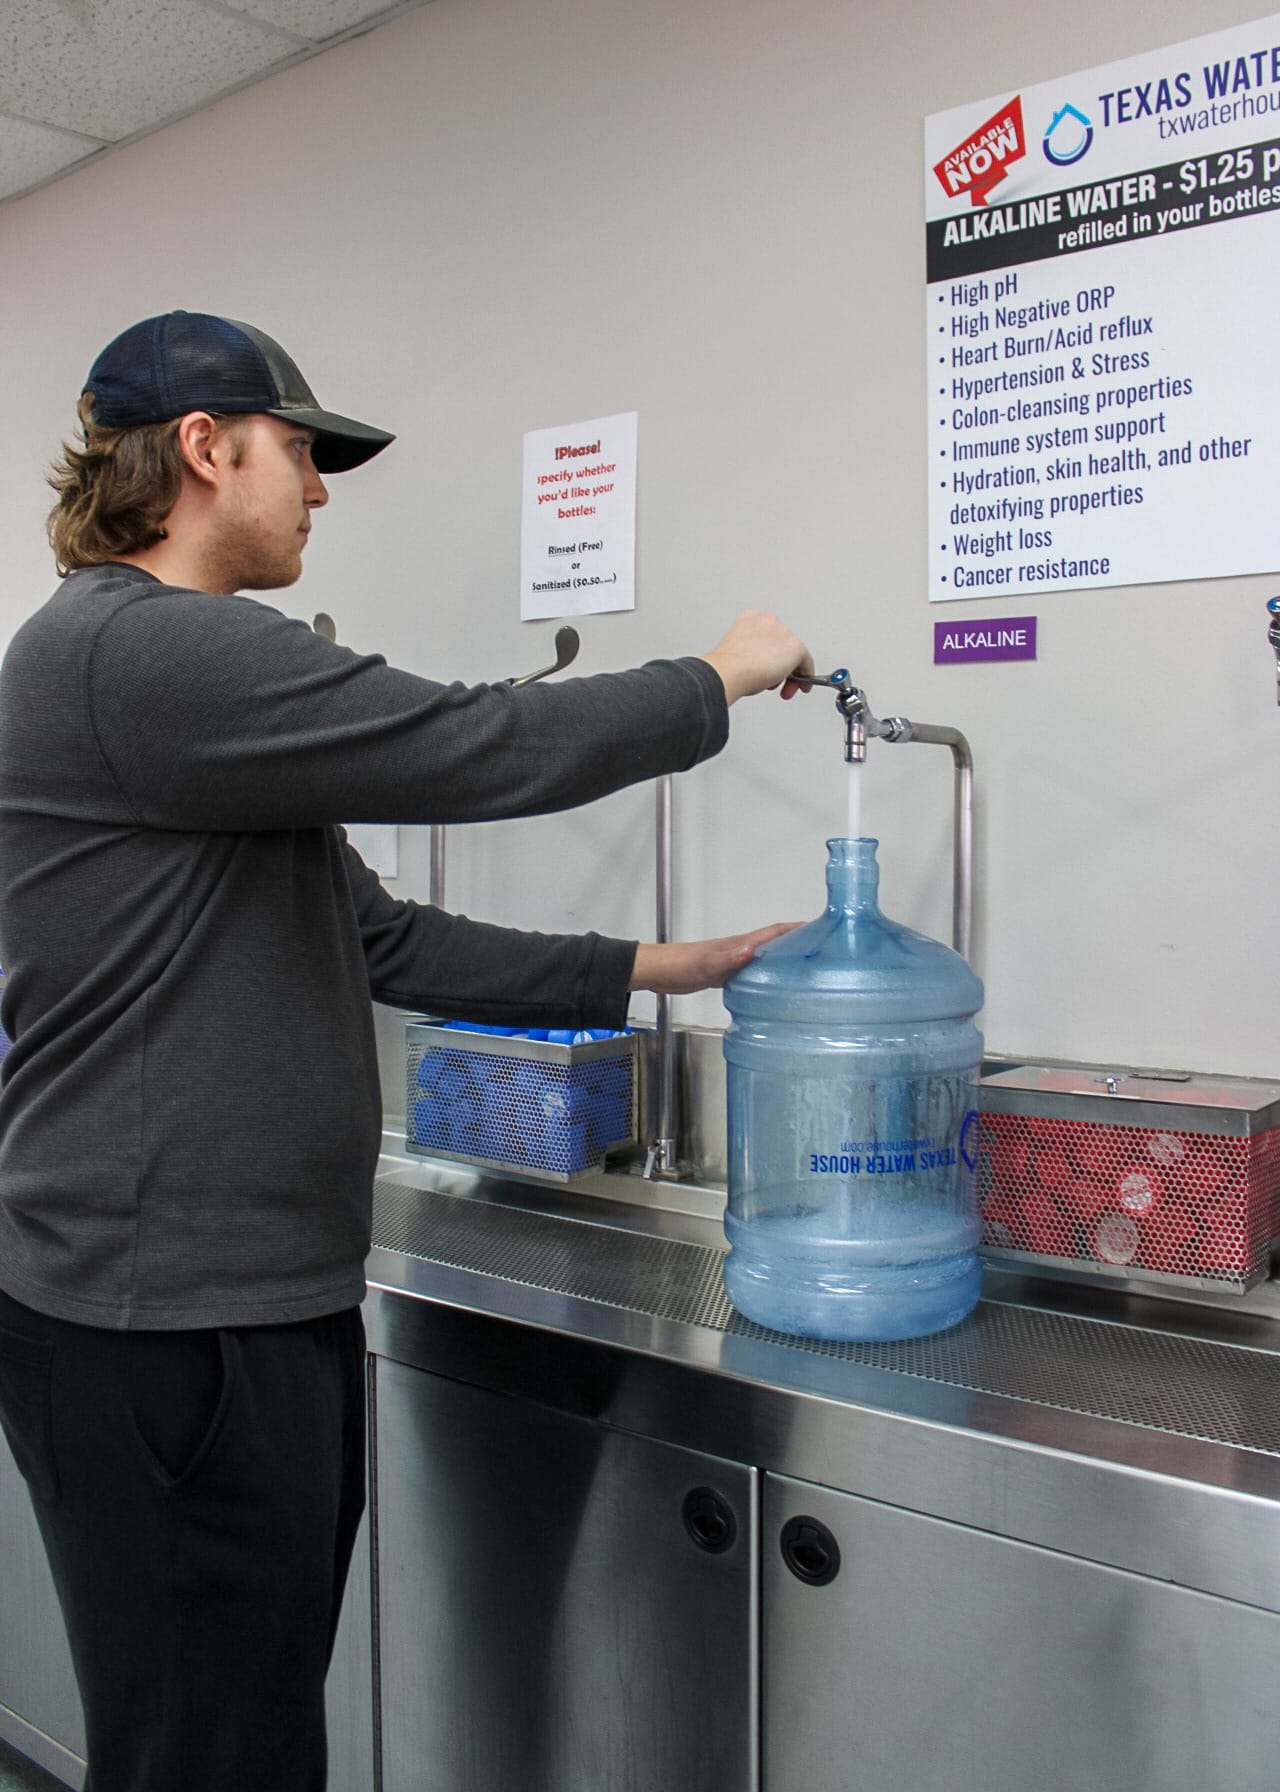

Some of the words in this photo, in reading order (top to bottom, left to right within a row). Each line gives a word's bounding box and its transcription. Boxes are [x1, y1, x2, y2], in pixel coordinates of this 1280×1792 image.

[1099, 72, 1191, 127] TEXAS
[1203, 46, 1280, 100] WATE
[944, 116, 1014, 172] AVAILABLE
[945, 127, 1020, 193] NOW
[943, 195, 1062, 247] ALKALINE
[1067, 173, 1157, 219] WATER
[1179, 149, 1254, 194] $1.25
[1058, 216, 1127, 249] refilled
[1133, 212, 1151, 234] in
[1157, 201, 1203, 233] your
[1209, 184, 1280, 217] bottles
[951, 282, 989, 308] High
[994, 273, 1018, 303] pH
[951, 312, 989, 338] High
[995, 298, 1070, 330] Negative
[1077, 286, 1116, 313] ORP
[952, 341, 998, 368] Heart
[1004, 322, 1093, 358] Burn/Acid
[1100, 315, 1153, 341] reflux
[952, 363, 1065, 400] Hypertension
[1072, 357, 1085, 379] &
[1092, 350, 1150, 377] Stress
[952, 392, 1090, 430] Colon-cleansing
[1096, 376, 1193, 409] properties
[953, 437, 1020, 462] Immune
[1026, 424, 1088, 452] system
[1095, 412, 1166, 444] support
[537, 470, 574, 485] specify
[576, 463, 616, 479] whether
[953, 467, 1041, 495] Hydration,
[1046, 457, 1082, 481] skin
[1088, 448, 1151, 477] health,
[1158, 441, 1192, 467] and
[1199, 436, 1252, 462] other
[537, 489, 568, 504] you'd
[571, 486, 590, 498] like
[592, 481, 615, 497] your
[950, 495, 1044, 525] detoxifying
[1050, 485, 1144, 518] properties
[557, 506, 597, 519] bottles:
[548, 543, 576, 555] Rinsed
[578, 539, 604, 554] (Free)
[953, 530, 1013, 558] Weight
[1018, 528, 1053, 551] loss
[571, 562, 581, 570] or
[953, 564, 1013, 588] Cancer
[1018, 556, 1110, 582] resistance
[532, 578, 571, 591] Sanitized
[943, 630, 1027, 650] ALKALINE
[810, 1154, 861, 1173] HOUSE
[866, 1153, 916, 1174] WATER
[920, 1149, 956, 1169] TEXAS
